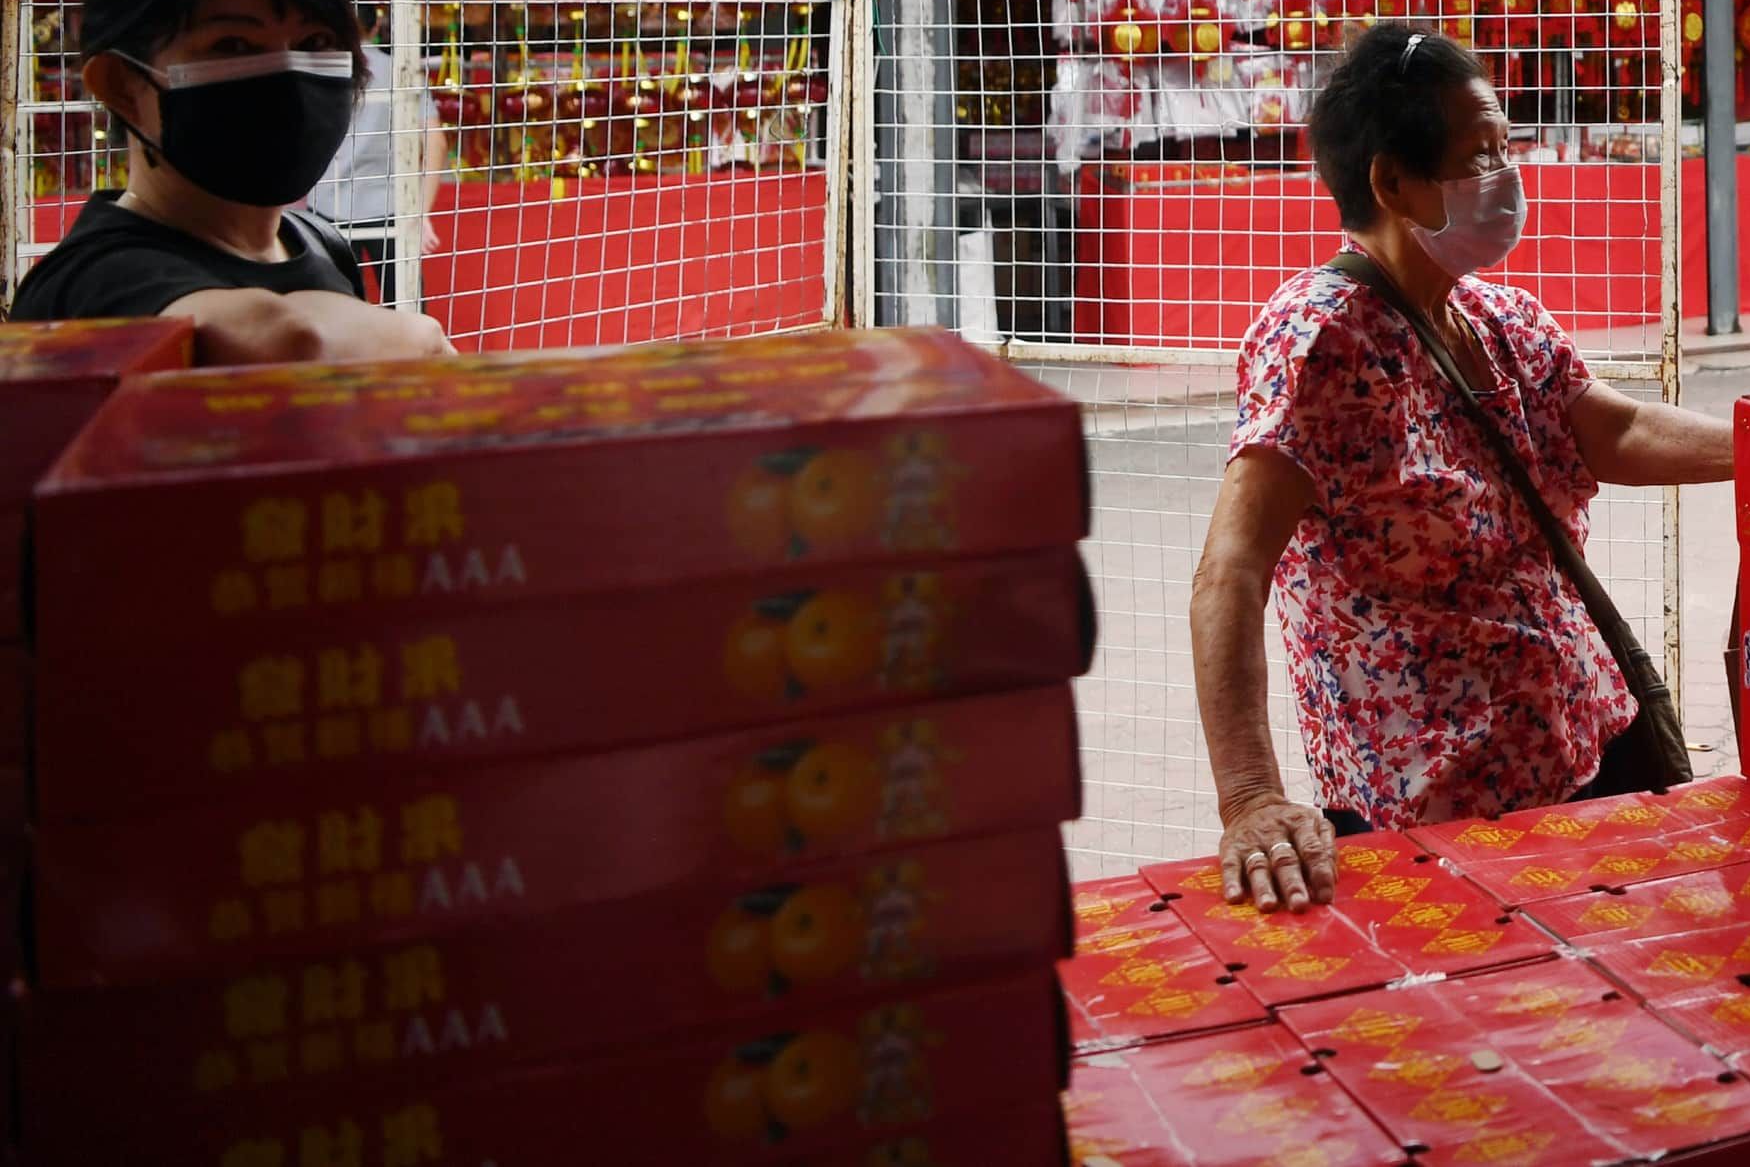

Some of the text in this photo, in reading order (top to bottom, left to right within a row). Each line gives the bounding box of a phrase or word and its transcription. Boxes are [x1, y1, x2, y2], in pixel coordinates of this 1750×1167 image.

[423, 541, 528, 594] AAA
[421, 693, 525, 746] AAA
[421, 854, 525, 912] AAA
[406, 1002, 508, 1056] AAA
